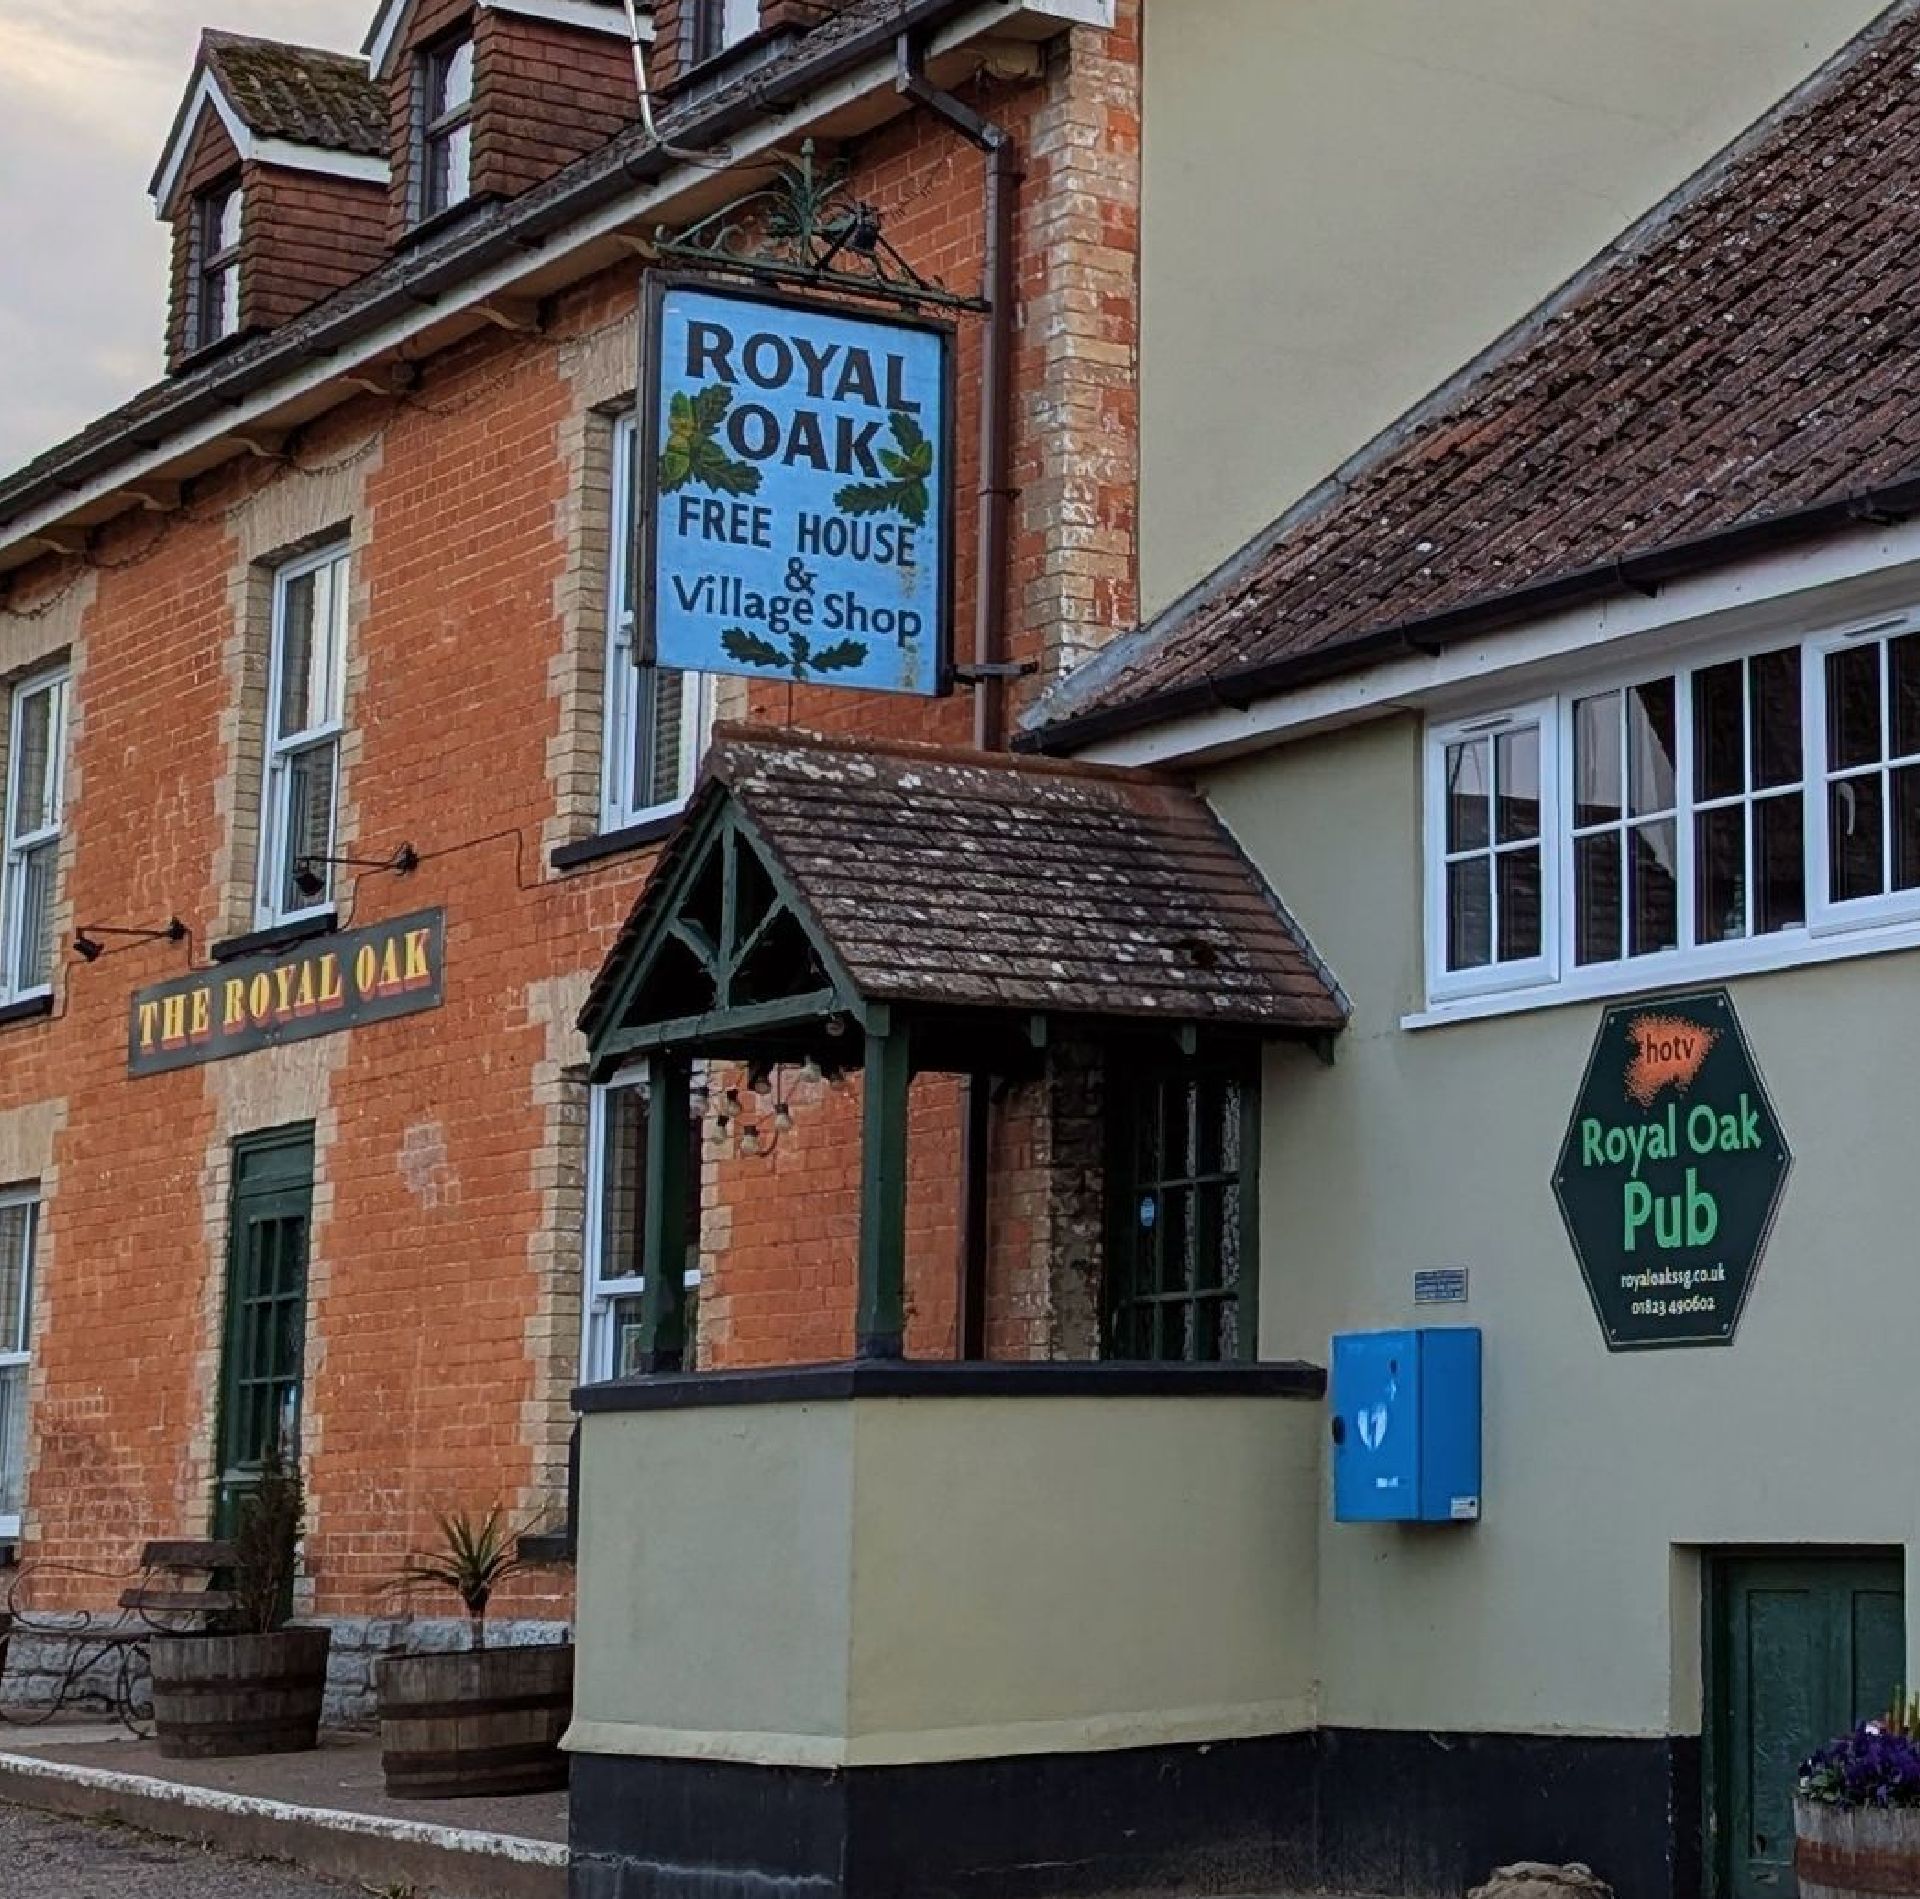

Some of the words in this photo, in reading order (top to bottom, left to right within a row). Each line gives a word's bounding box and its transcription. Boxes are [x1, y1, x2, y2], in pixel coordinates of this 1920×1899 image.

[685, 320, 921, 414] ROYAL
[726, 404, 883, 479] OAK
[677, 495, 772, 549] FREE
[798, 511, 916, 567] HOUSE
[671, 574, 814, 634] Village
[821, 591, 922, 647] Shop
[784, 556, 818, 595] &
[138, 986, 213, 1056] THE
[222, 952, 344, 1036] ROYAL
[355, 927, 432, 1002] OAK
[1582, 1103, 1677, 1177] Royal
[1687, 1093, 1762, 1153] Oak
[1624, 1167, 1718, 1251] Pub
[1632, 1298, 1665, 1316] 01823
